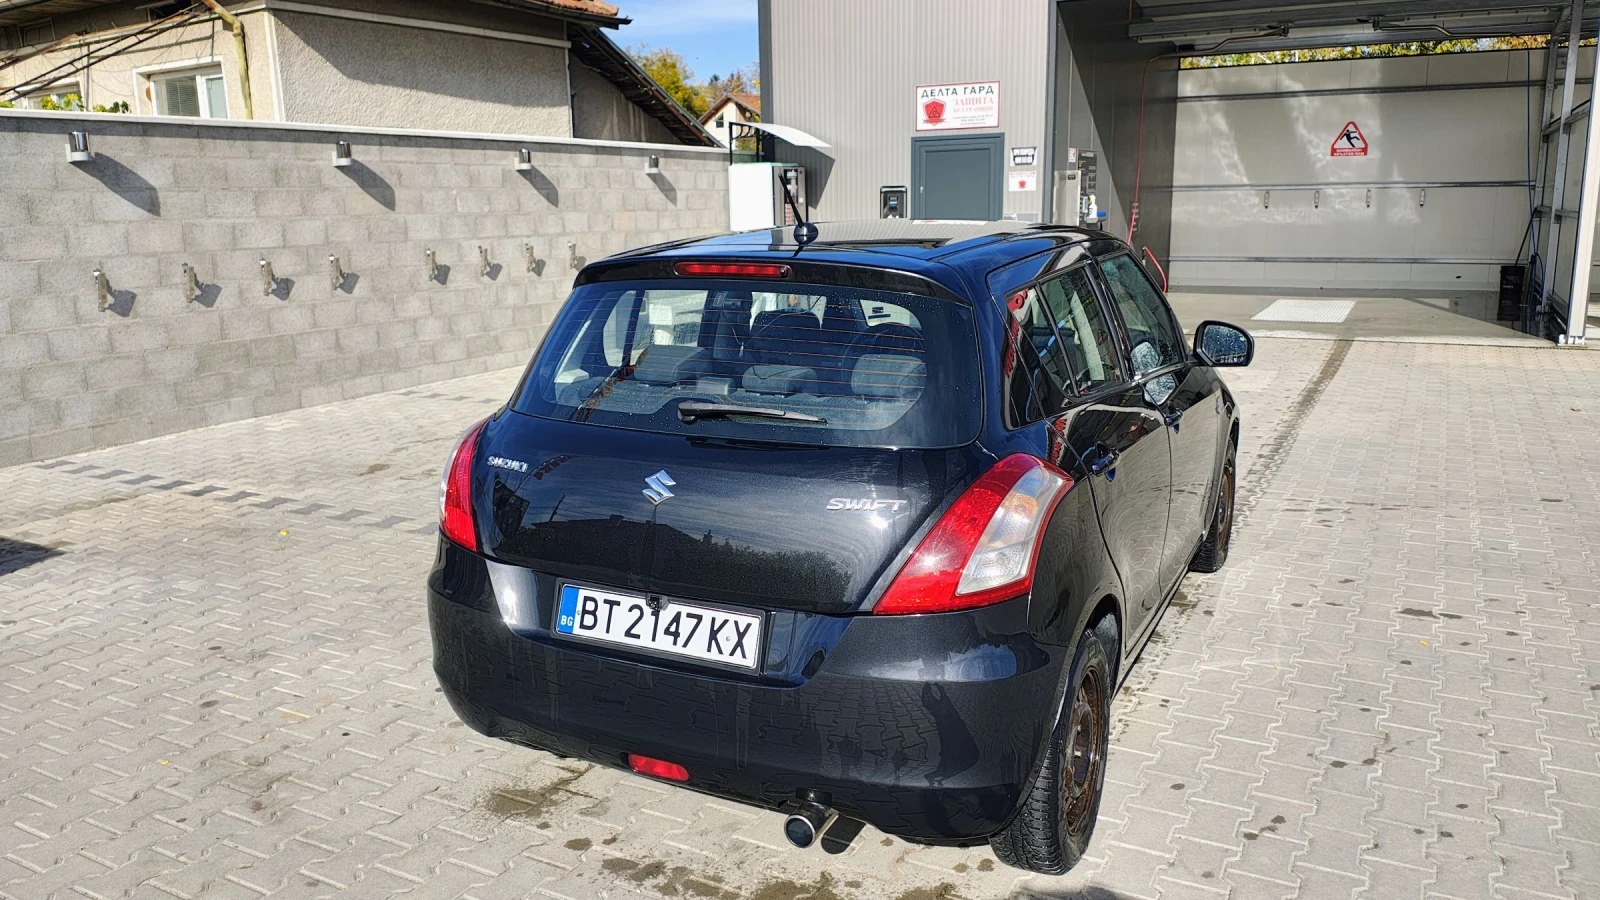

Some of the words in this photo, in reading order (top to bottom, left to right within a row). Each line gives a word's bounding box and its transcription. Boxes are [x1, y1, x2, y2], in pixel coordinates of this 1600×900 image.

[921, 88, 958, 99] ДЕЛТА
[963, 85, 994, 95] ГАРД
[952, 97, 994, 106] ЗАЩИТА
[487, 455, 529, 473] SUZUKI
[826, 496, 908, 512] SWIFT
[560, 615, 573, 627] BG
[624, 603, 704, 648] 2147
